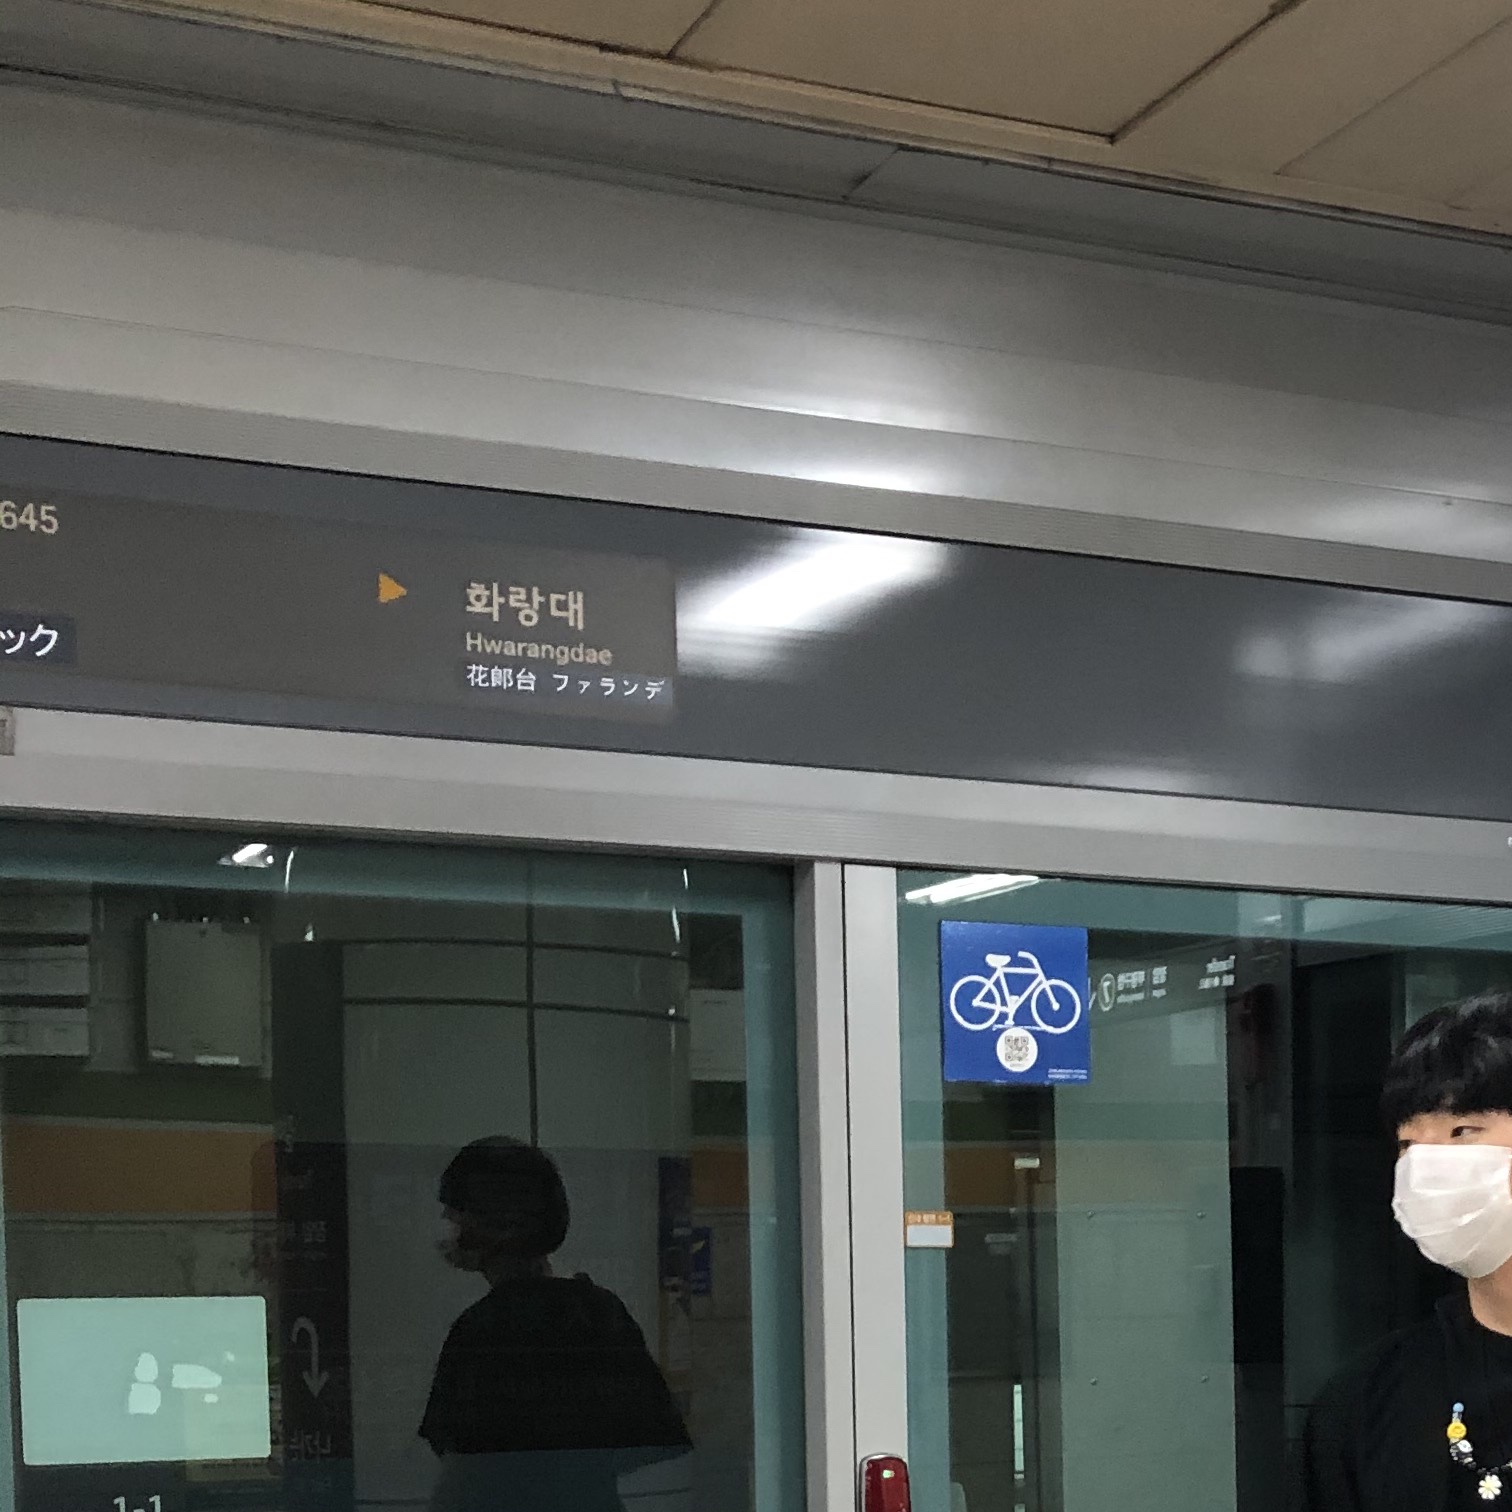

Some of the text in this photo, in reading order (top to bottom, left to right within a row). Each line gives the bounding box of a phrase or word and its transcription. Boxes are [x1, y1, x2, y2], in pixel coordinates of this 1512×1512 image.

[0, 500, 59, 535] 645
[465, 580, 585, 631] 화랑대
[465, 631, 613, 666] Hwarangdae
[553, 673, 665, 701] ファランデ
